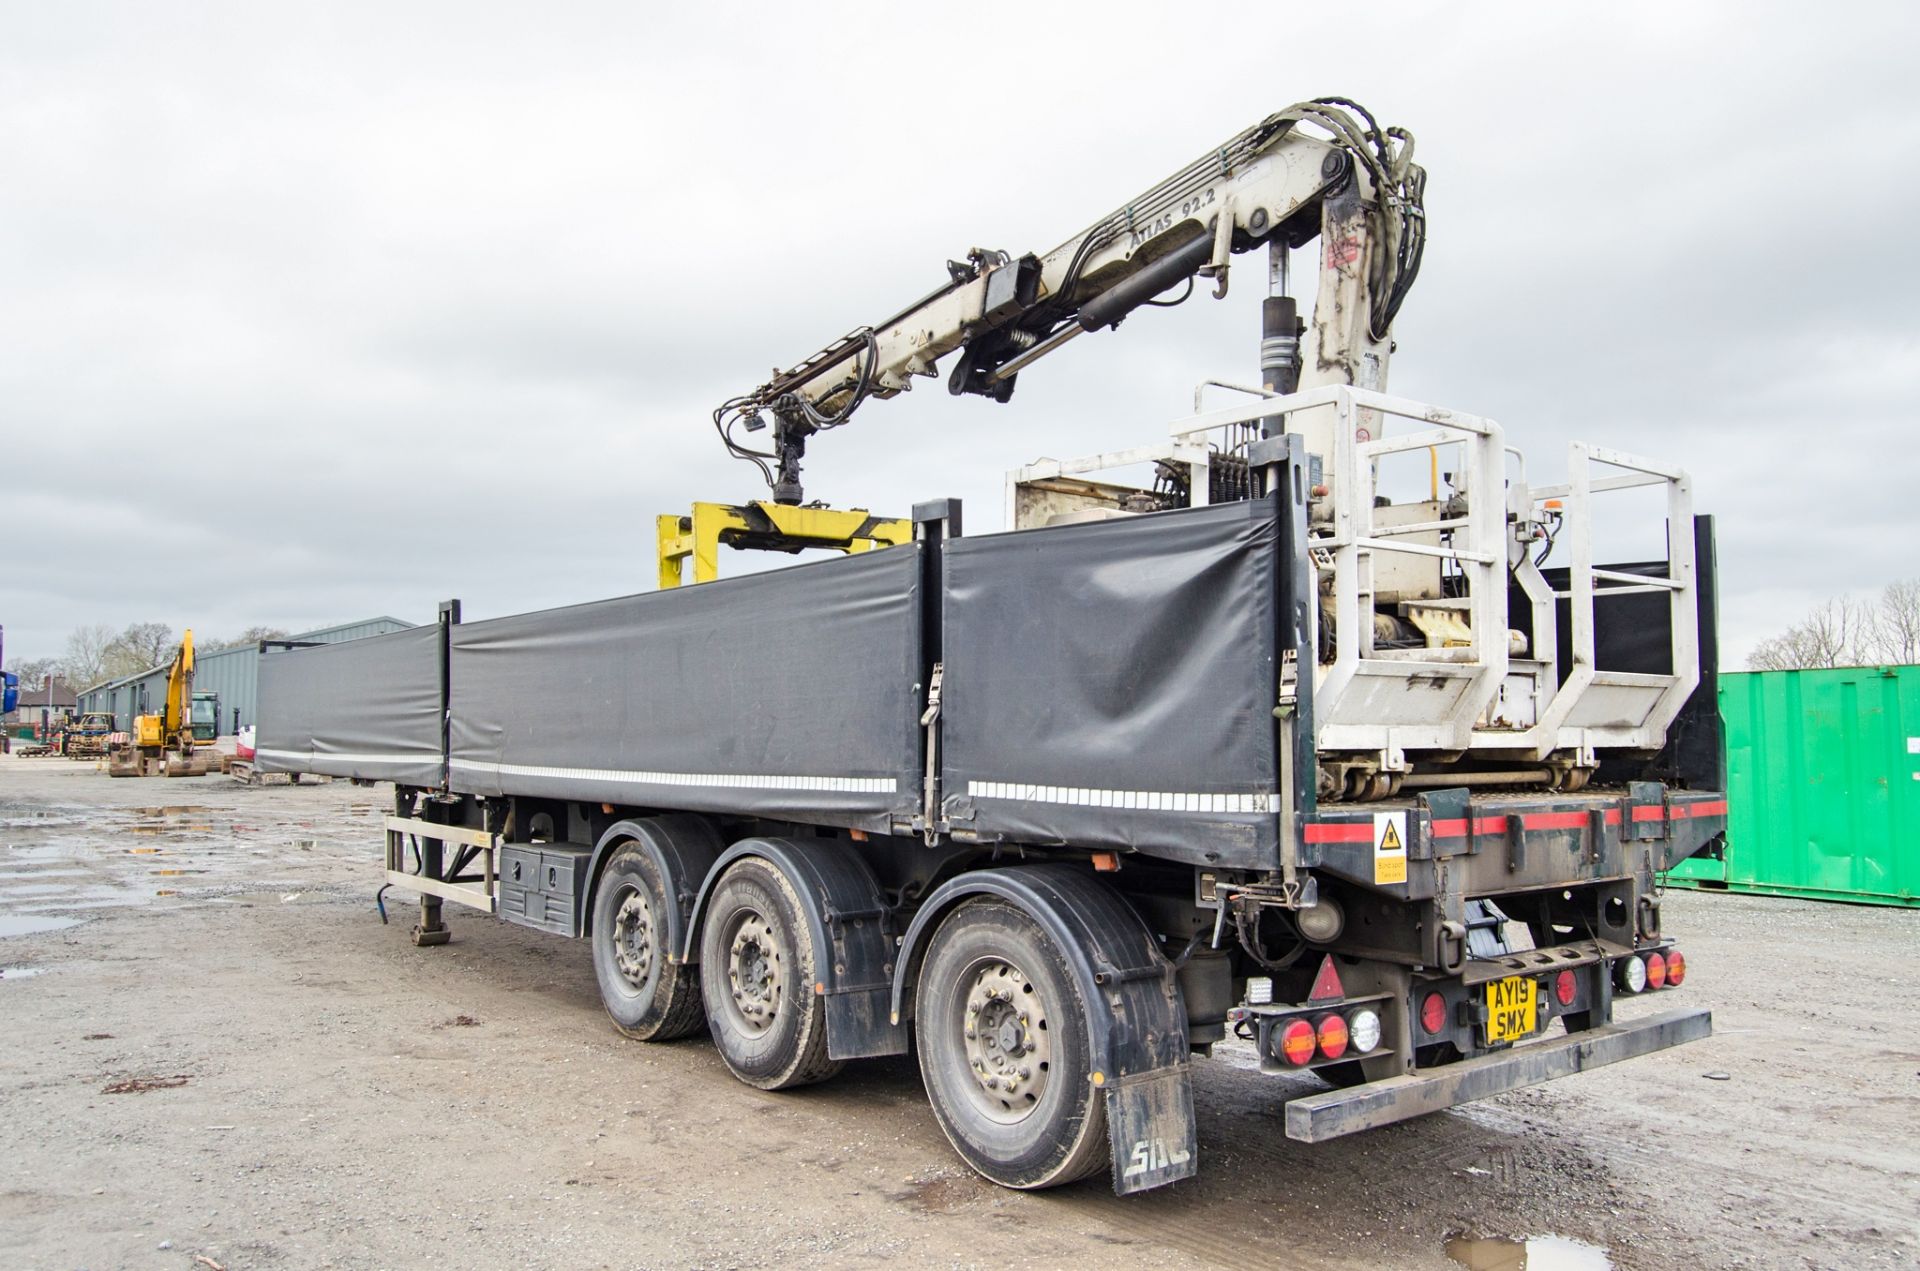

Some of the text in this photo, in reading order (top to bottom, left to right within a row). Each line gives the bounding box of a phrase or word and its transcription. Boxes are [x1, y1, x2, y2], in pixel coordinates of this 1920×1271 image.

[1130, 188, 1216, 249] ATLAS 92.2
[1495, 979, 1528, 1008] AY19
[1497, 1008, 1526, 1037] SMX
